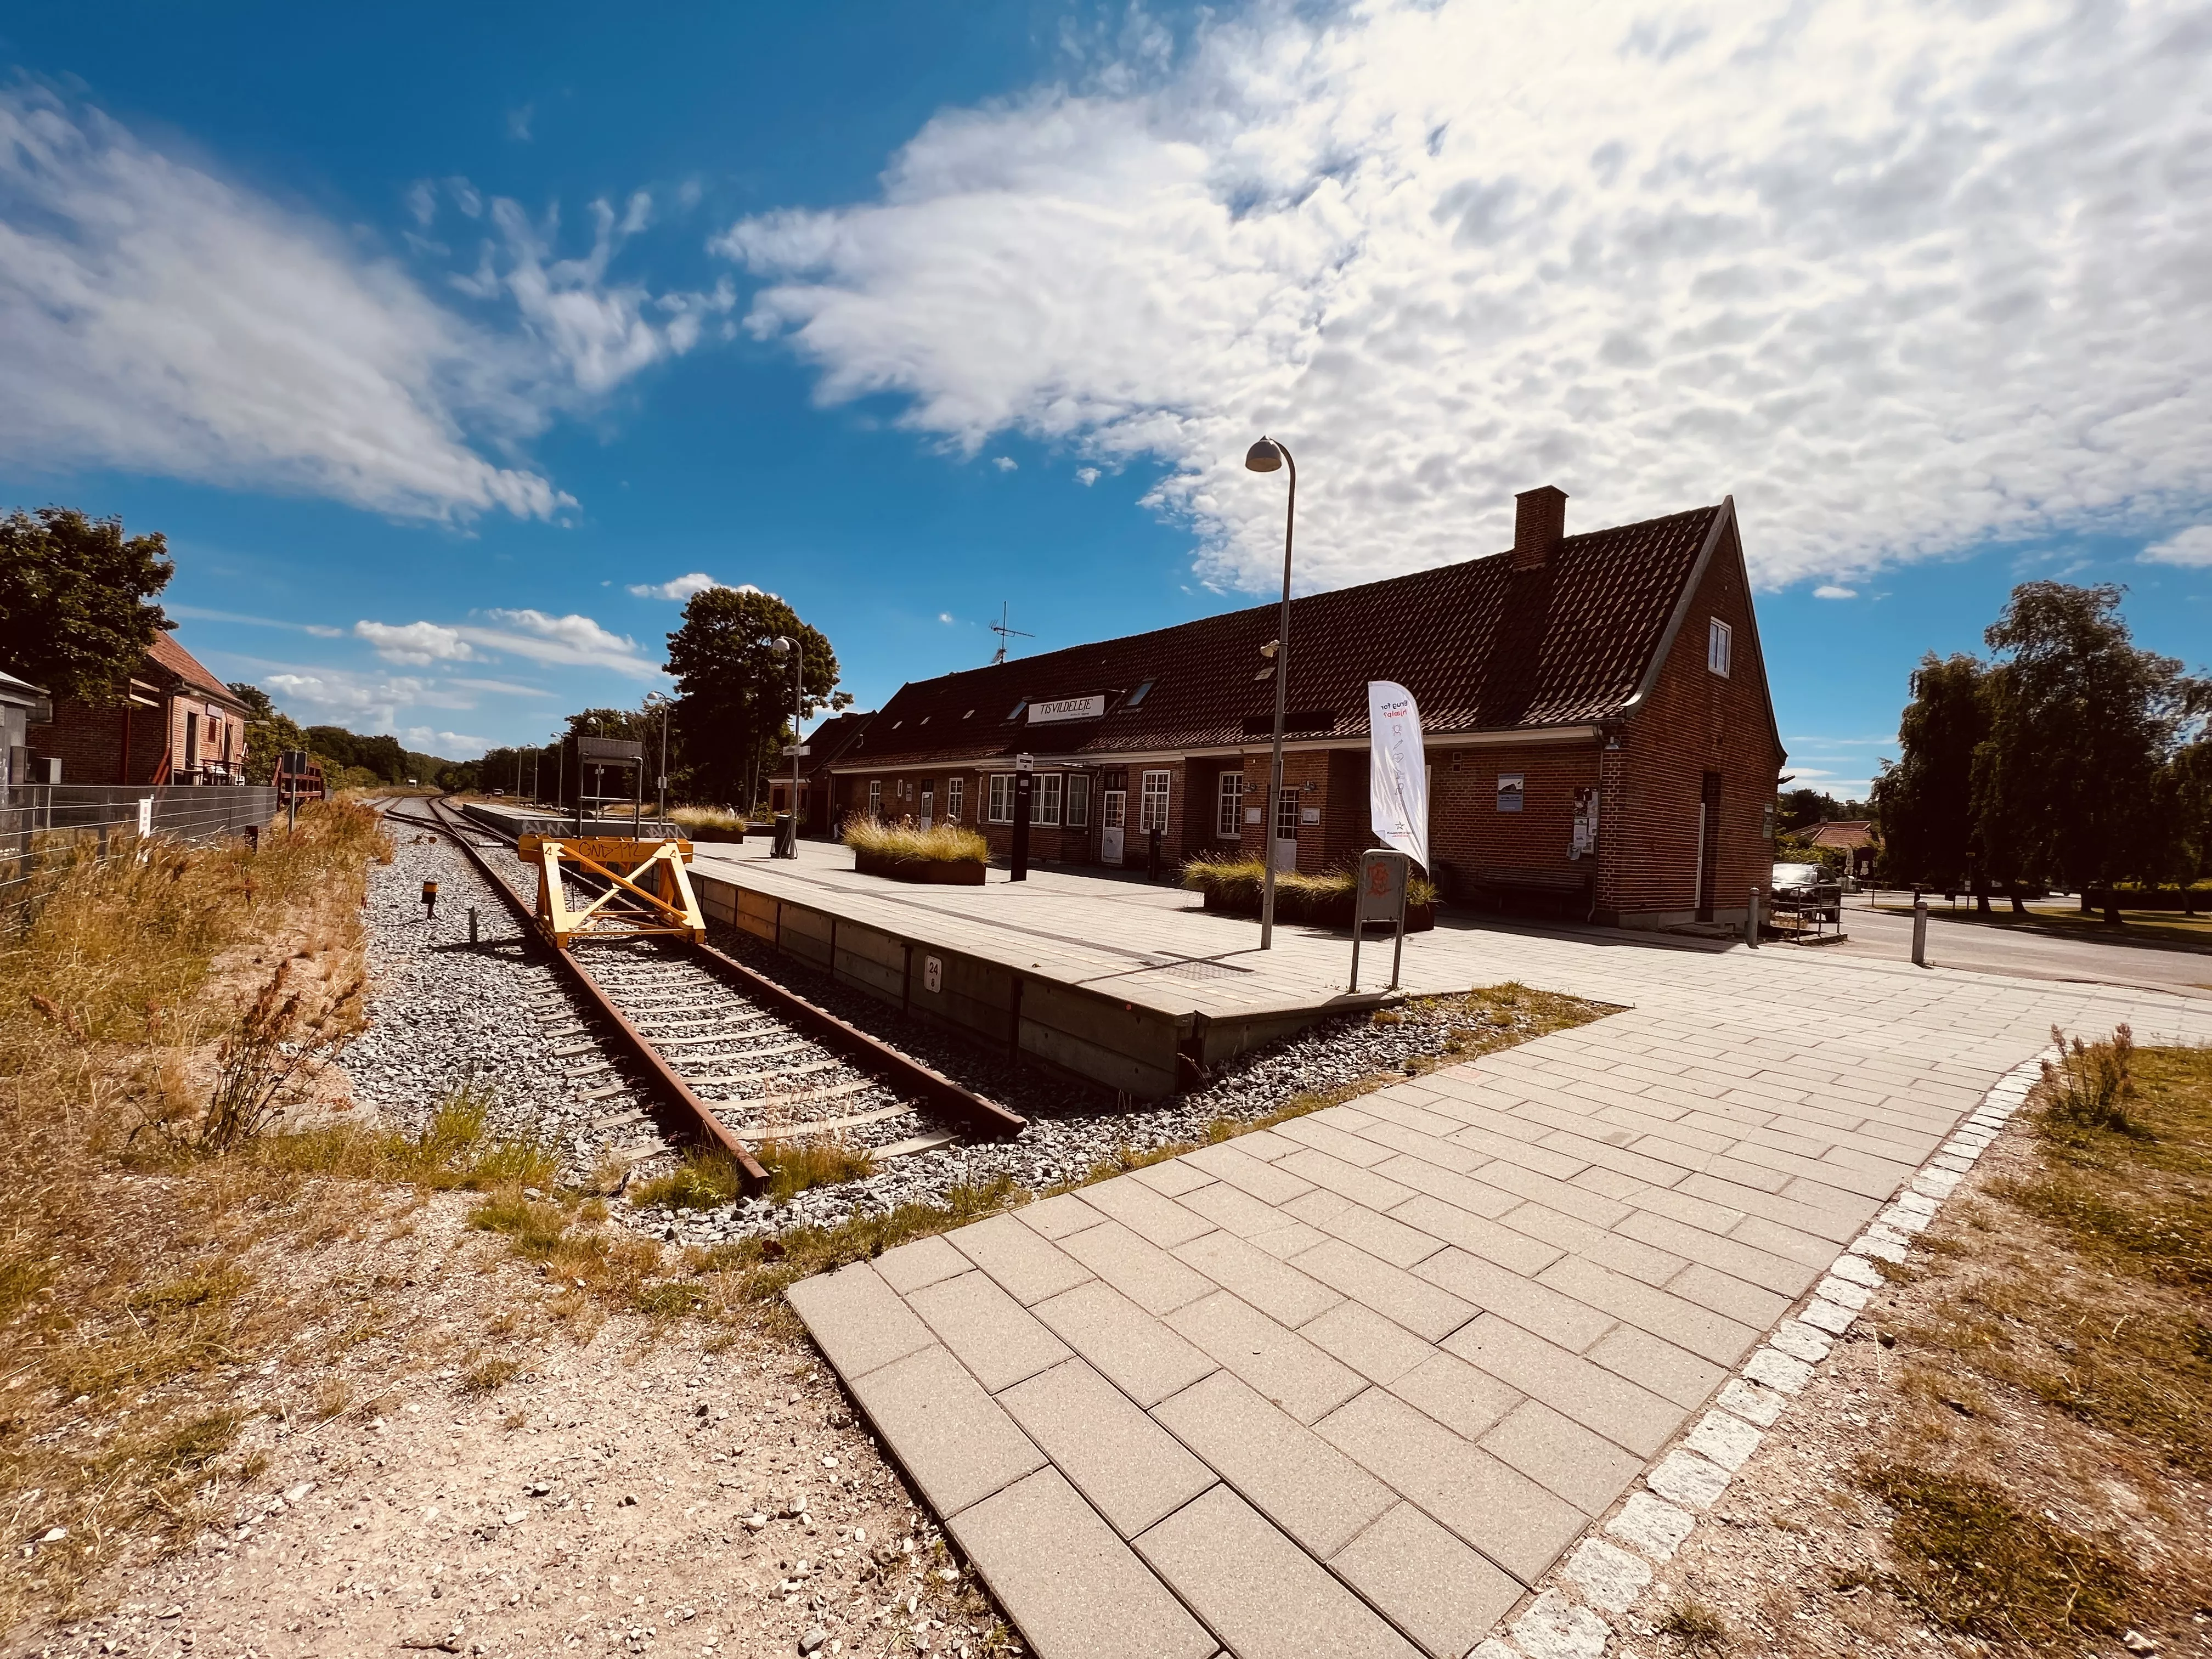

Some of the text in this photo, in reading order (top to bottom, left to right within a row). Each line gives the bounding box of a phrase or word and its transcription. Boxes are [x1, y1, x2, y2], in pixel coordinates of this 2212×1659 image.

[1041, 698, 1093, 715] TISVILDELEJE
[929, 962, 938, 975] 24
[930, 978, 935, 988] 8
